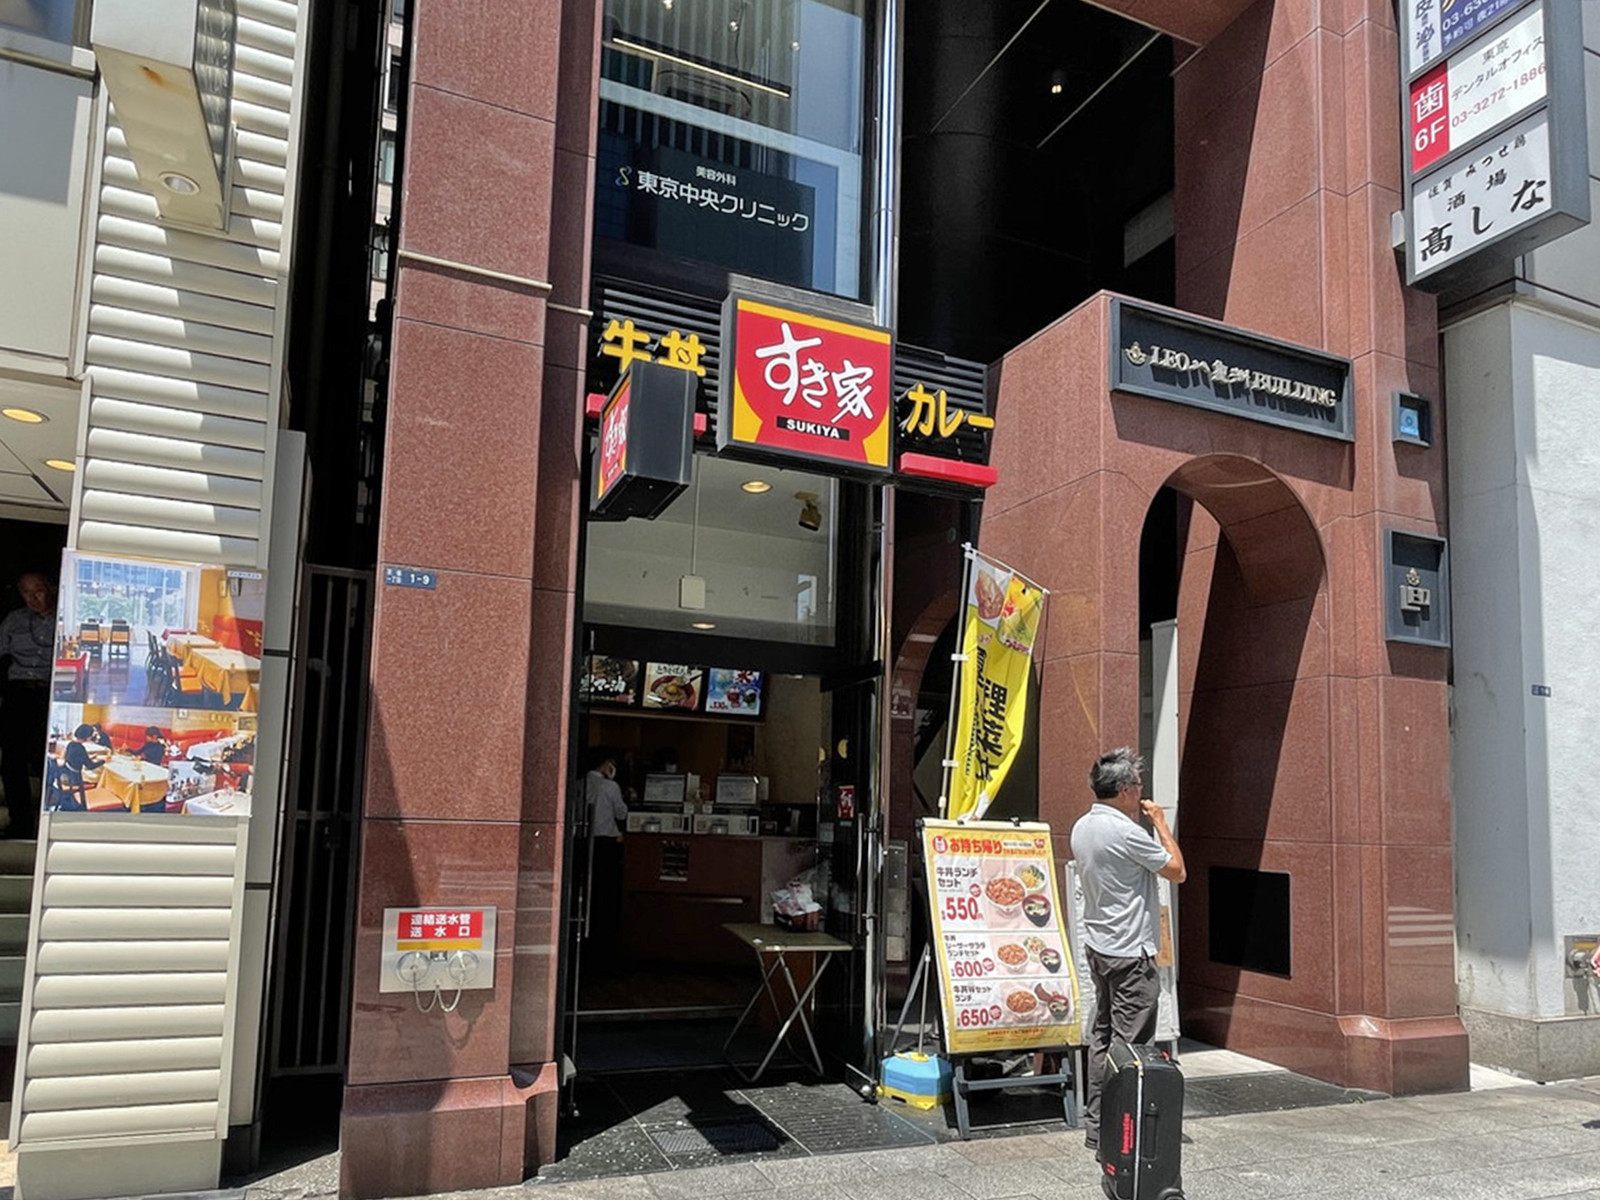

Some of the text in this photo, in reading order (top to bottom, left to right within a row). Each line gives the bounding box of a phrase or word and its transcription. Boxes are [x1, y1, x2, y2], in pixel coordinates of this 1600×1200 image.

[1482, 38, 1509, 65] 東京
[1451, 36, 1545, 101] デンタルオフィス
[1414, 82, 1445, 123] 歯
[1451, 63, 1547, 127] 03-3272-1886
[1415, 115, 1446, 151] 6F
[696, 166, 737, 187] 美容外科
[637, 170, 809, 232] 東京中央クリニック
[755, 322, 874, 424] すき家
[907, 383, 995, 437] カレー
[786, 419, 840, 439] SUKIYA
[410, 573, 431, 585] 1-9
[950, 838, 1002, 855] お持ち帰り
[936, 866, 978, 878] 牛丼ランチ
[937, 878, 961, 888] セット
[411, 913, 471, 925] 連結送水管
